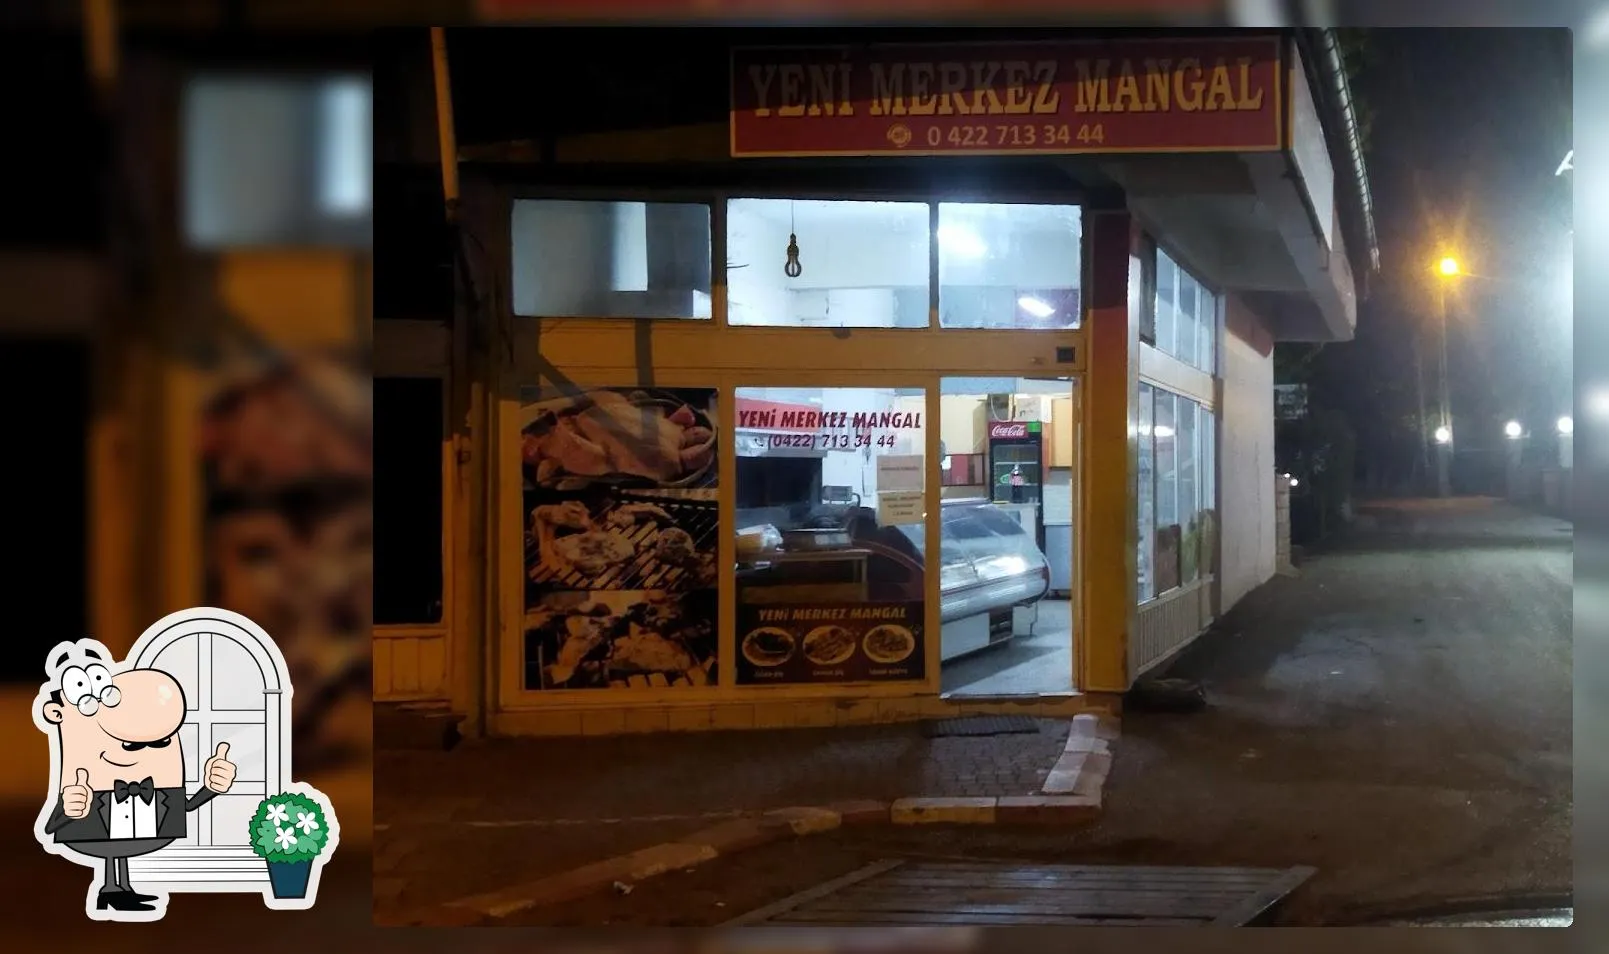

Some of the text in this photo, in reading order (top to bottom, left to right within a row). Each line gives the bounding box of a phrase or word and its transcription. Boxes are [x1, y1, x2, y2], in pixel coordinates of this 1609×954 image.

[748, 52, 1264, 117] YENİ MERKEZ MANGAL
[926, 122, 1105, 146] 0 422 713 34 44
[780, 411, 848, 429] MERKEZ
[852, 411, 921, 429] MANGAL
[767, 433, 896, 451] (0422) 713 34 44
